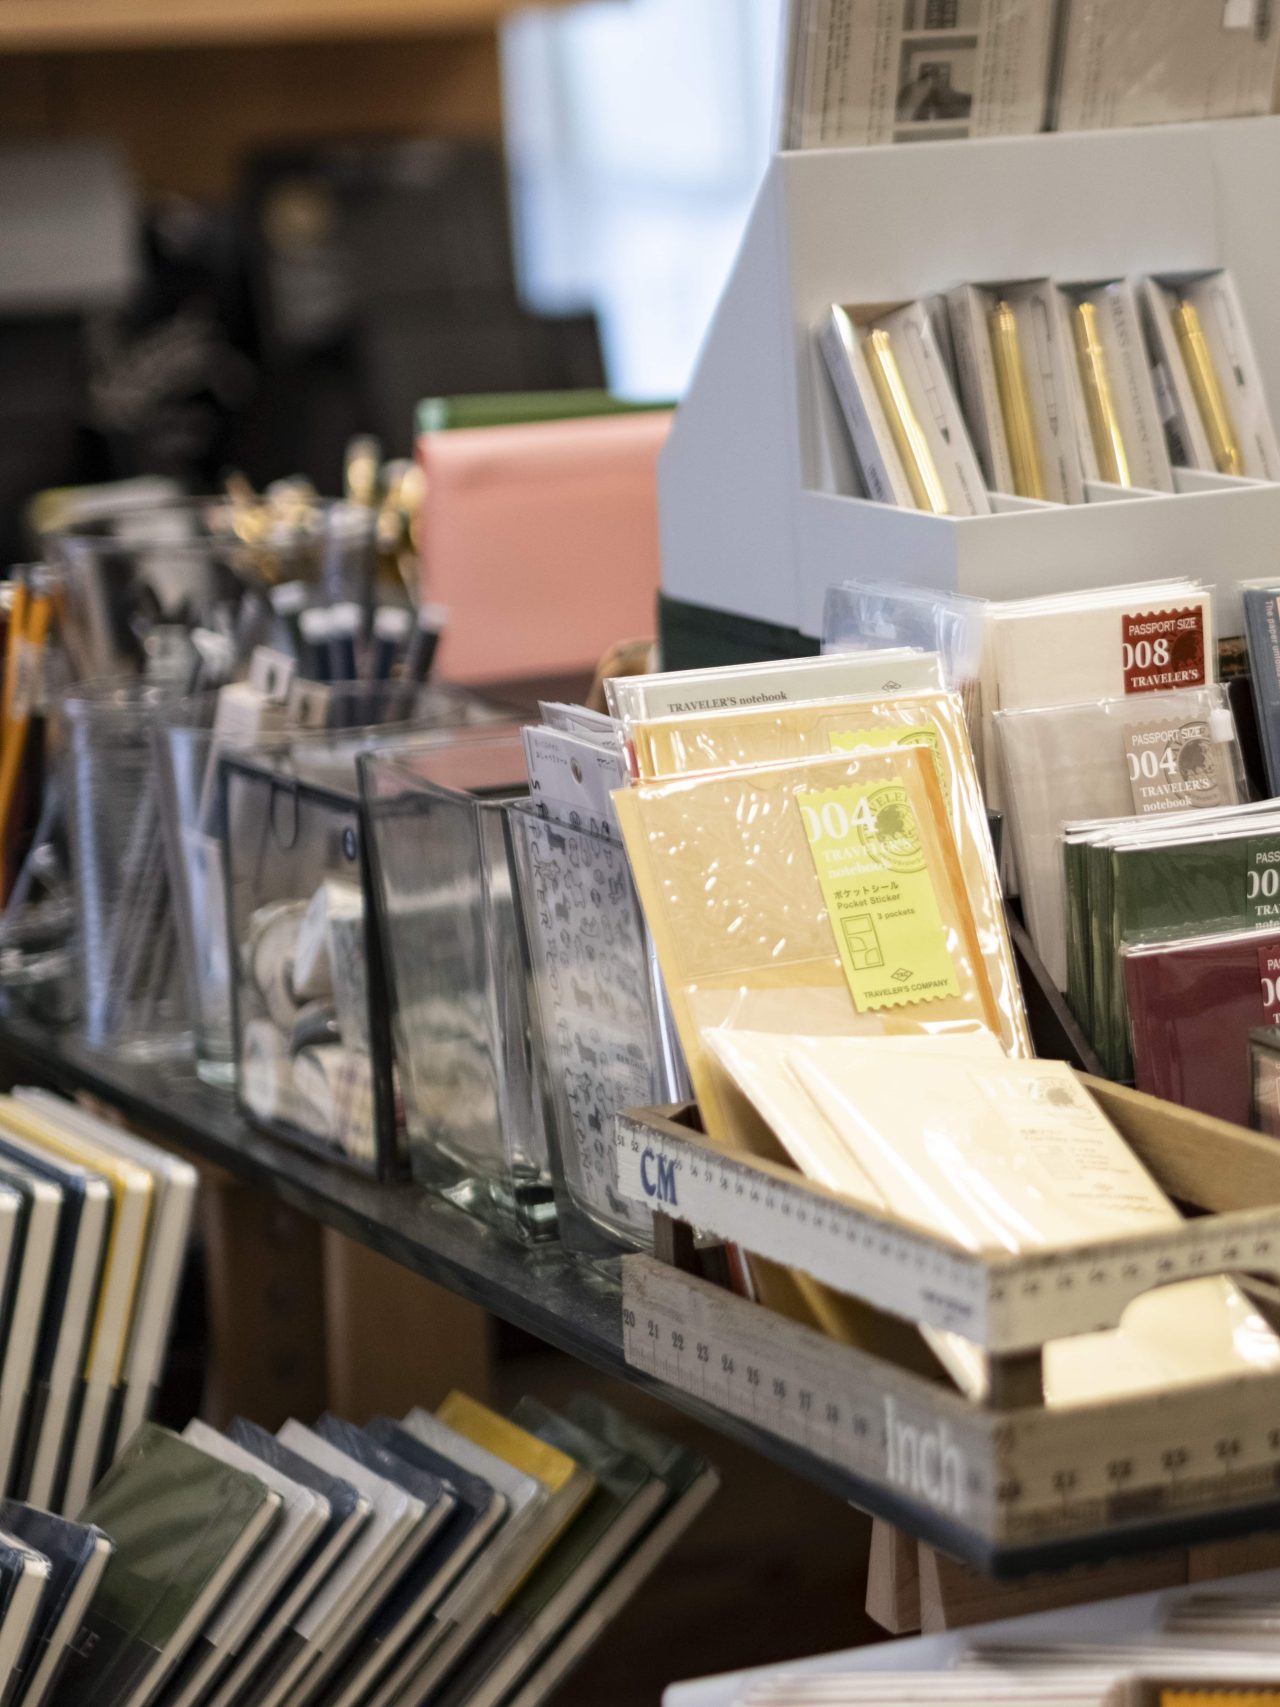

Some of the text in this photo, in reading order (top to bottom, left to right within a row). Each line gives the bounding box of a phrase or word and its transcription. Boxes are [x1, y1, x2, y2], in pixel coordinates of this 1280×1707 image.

[1265, 600, 1273, 619] The
[1129, 617, 1196, 636] PASSPORT SIZE
[1266, 619, 1278, 644] paper
[1131, 669, 1199, 688] TRAVELER'S
[667, 690, 788, 714] TRAVELER'S notebook
[1132, 726, 1202, 746] PASSPORT SIZE
[1140, 778, 1210, 798] TRAVELER'S
[1143, 795, 1193, 813] notebook
[823, 838, 914, 864] TRAVELER'S
[828, 859, 891, 880] notebook
[833, 881, 900, 899] ポケットシール
[837, 892, 901, 911] Pocket Sticker
[877, 908, 916, 920] 3 pockets
[864, 978, 949, 999] TRAVELER'S COMPANY
[640, 1147, 678, 1206] CM
[623, 1309, 635, 1328] 20
[648, 1320, 661, 1339] 21
[672, 1331, 685, 1352] 22
[697, 1341, 709, 1362] 23
[721, 1355, 735, 1375] 24
[747, 1366, 760, 1386] 25
[884, 1395, 964, 1516] Inch
